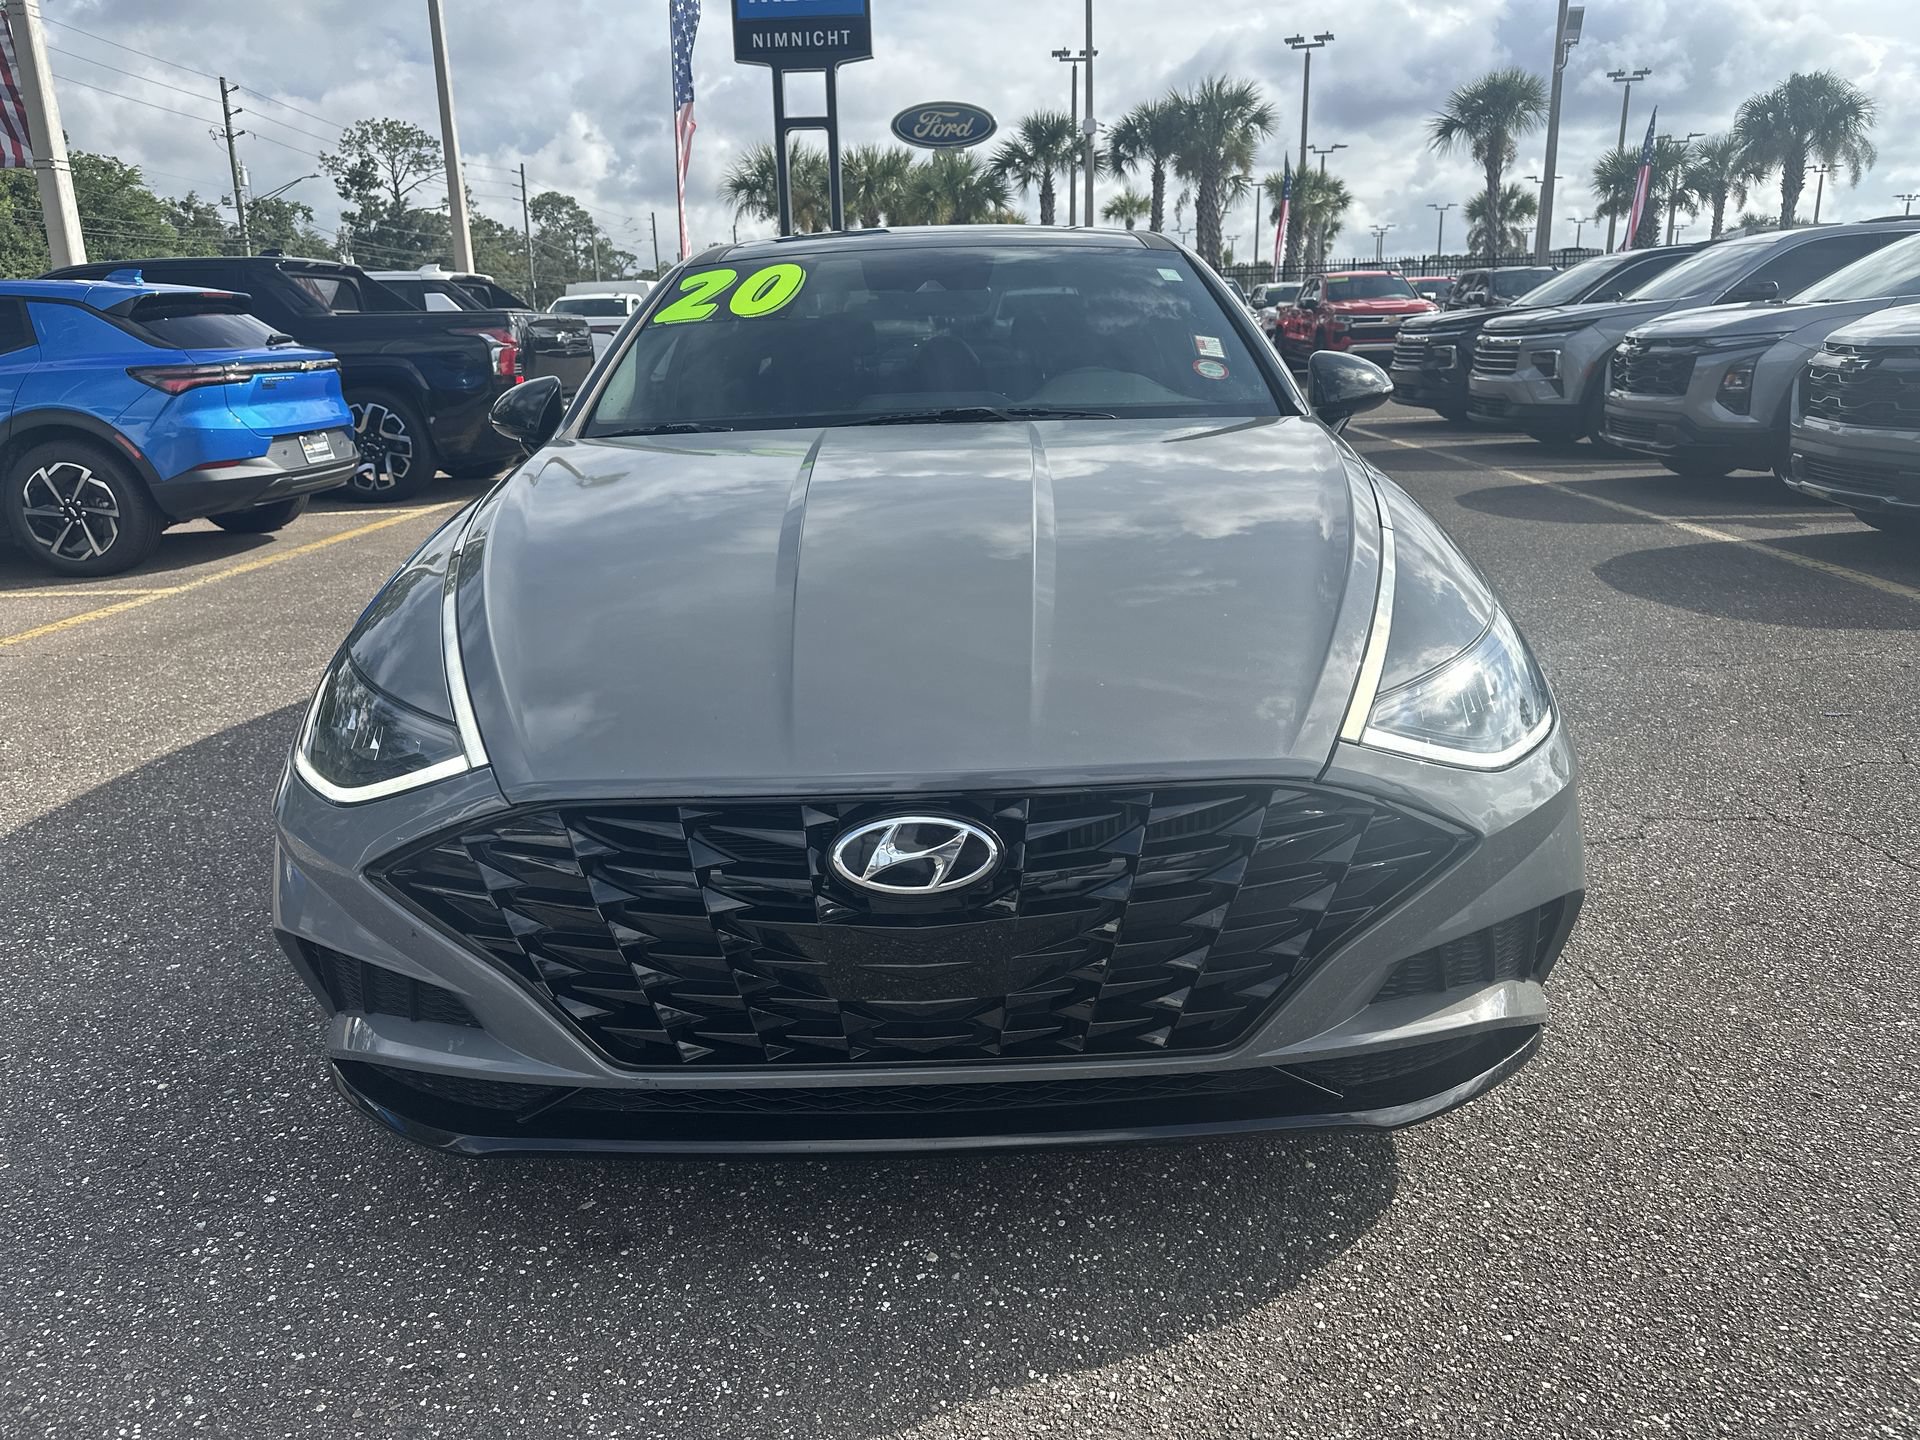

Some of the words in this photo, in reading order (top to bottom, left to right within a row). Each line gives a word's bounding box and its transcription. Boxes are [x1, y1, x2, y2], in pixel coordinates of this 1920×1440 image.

[752, 30, 850, 48] NIMNICHT
[913, 111, 975, 138] Ford
[653, 263, 807, 325] 20
